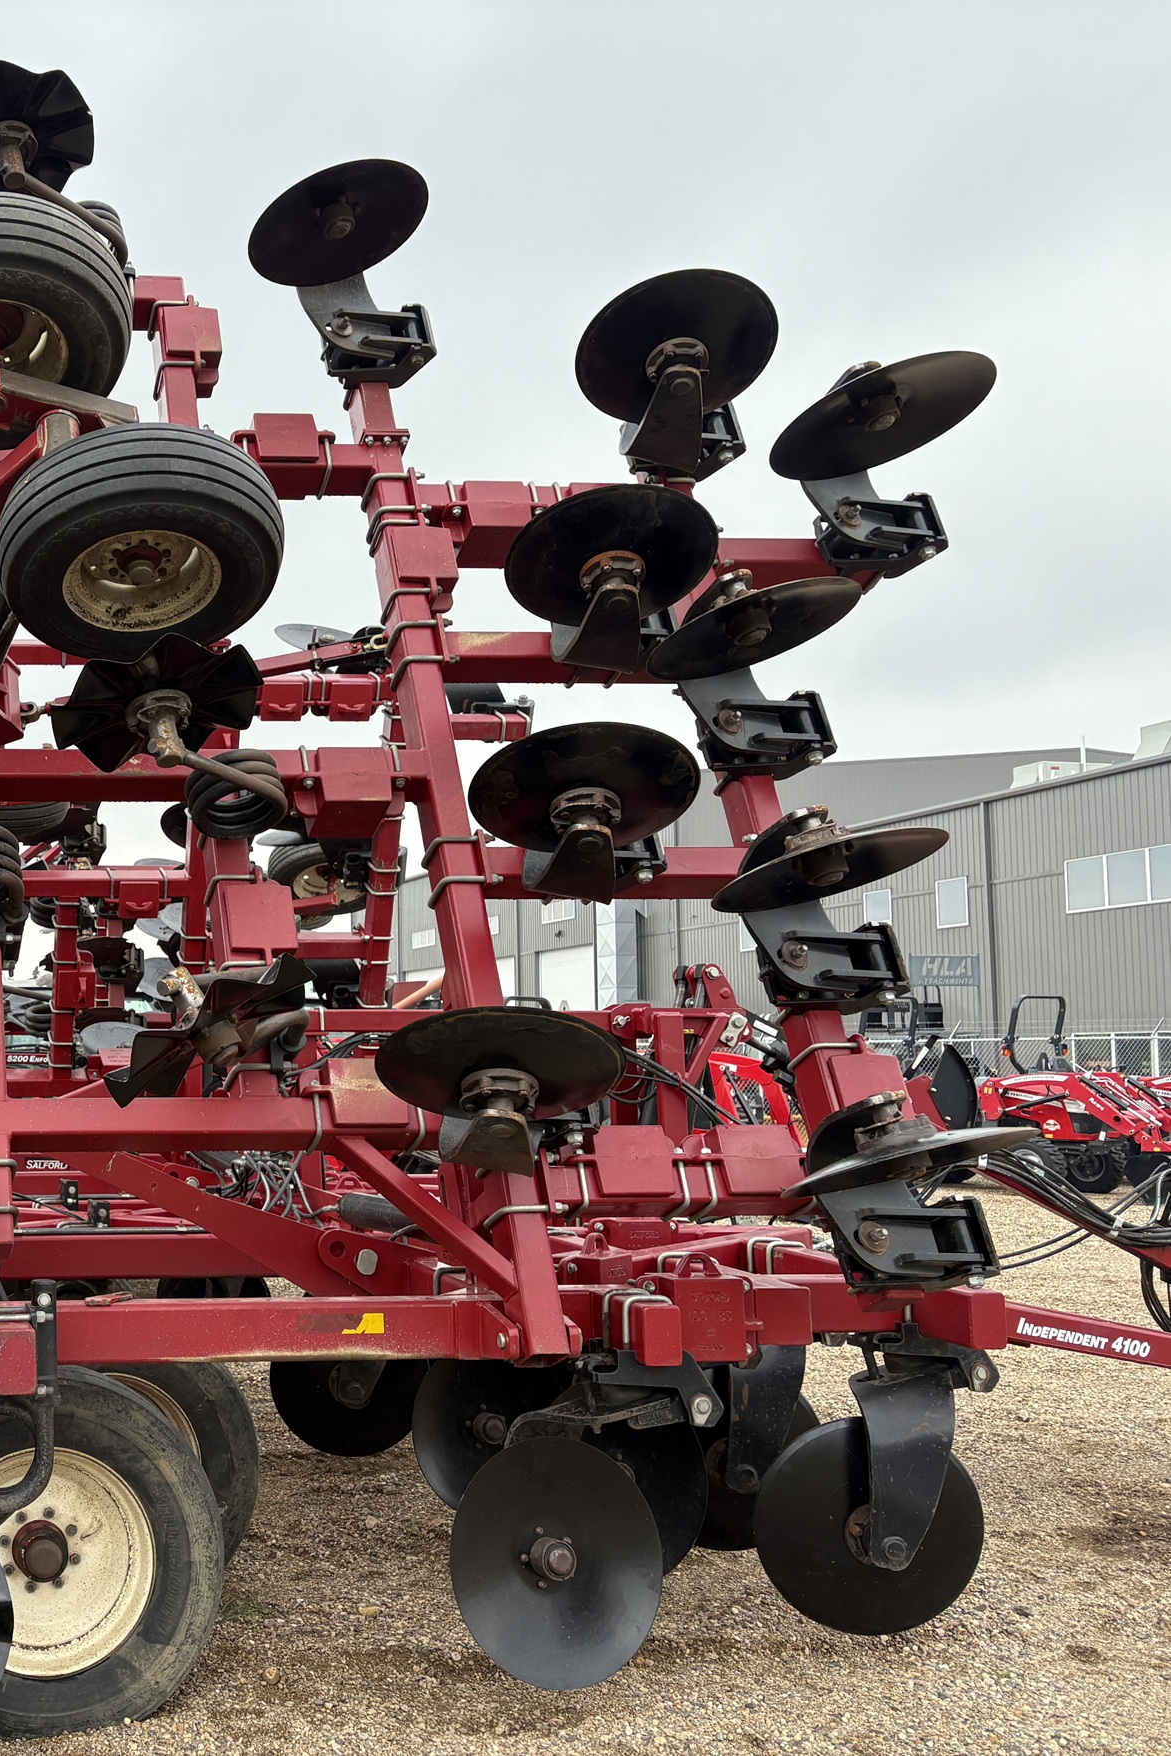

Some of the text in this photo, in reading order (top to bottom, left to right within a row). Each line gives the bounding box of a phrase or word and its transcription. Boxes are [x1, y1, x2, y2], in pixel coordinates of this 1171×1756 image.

[920, 956, 973, 977] HLA
[918, 976, 974, 985] ATTACHMENTS
[6, 1055, 49, 1063] 5200 ENFO
[688, 1309, 708, 1322] 100
[1017, 1317, 1151, 1358] INDEPENDENT 4100
